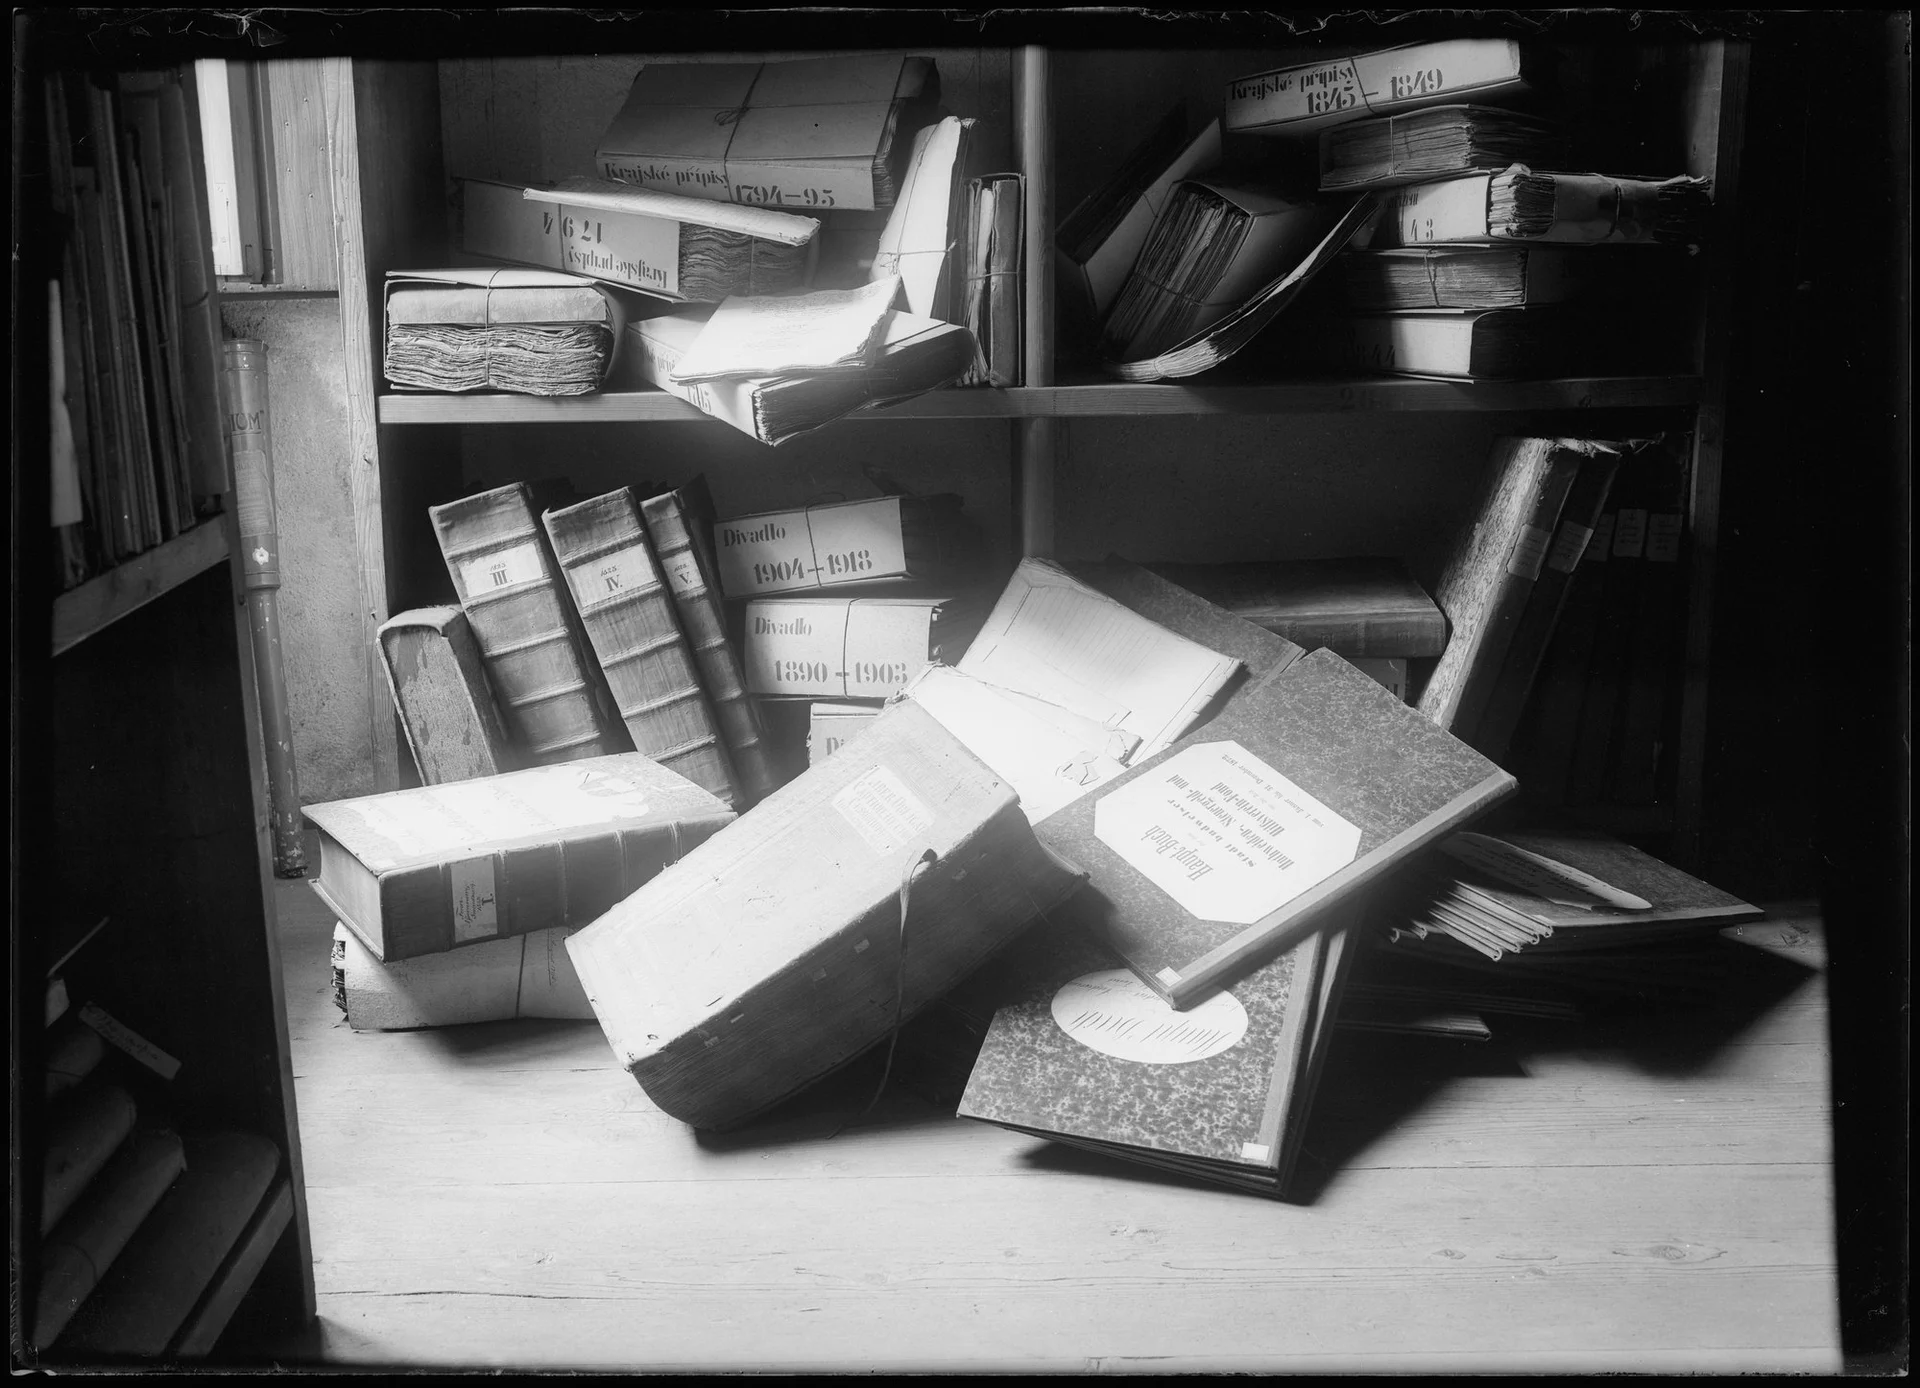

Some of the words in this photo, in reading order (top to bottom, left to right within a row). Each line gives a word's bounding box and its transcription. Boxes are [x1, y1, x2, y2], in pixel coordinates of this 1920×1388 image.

[1229, 73, 1292, 102] Krajské
[1306, 82, 1356, 114] 1845
[1390, 67, 1443, 99] 1849
[723, 523, 786, 547] Divadlo
[604, 574, 623, 592] IV.
[754, 617, 812, 636] Divadlo
